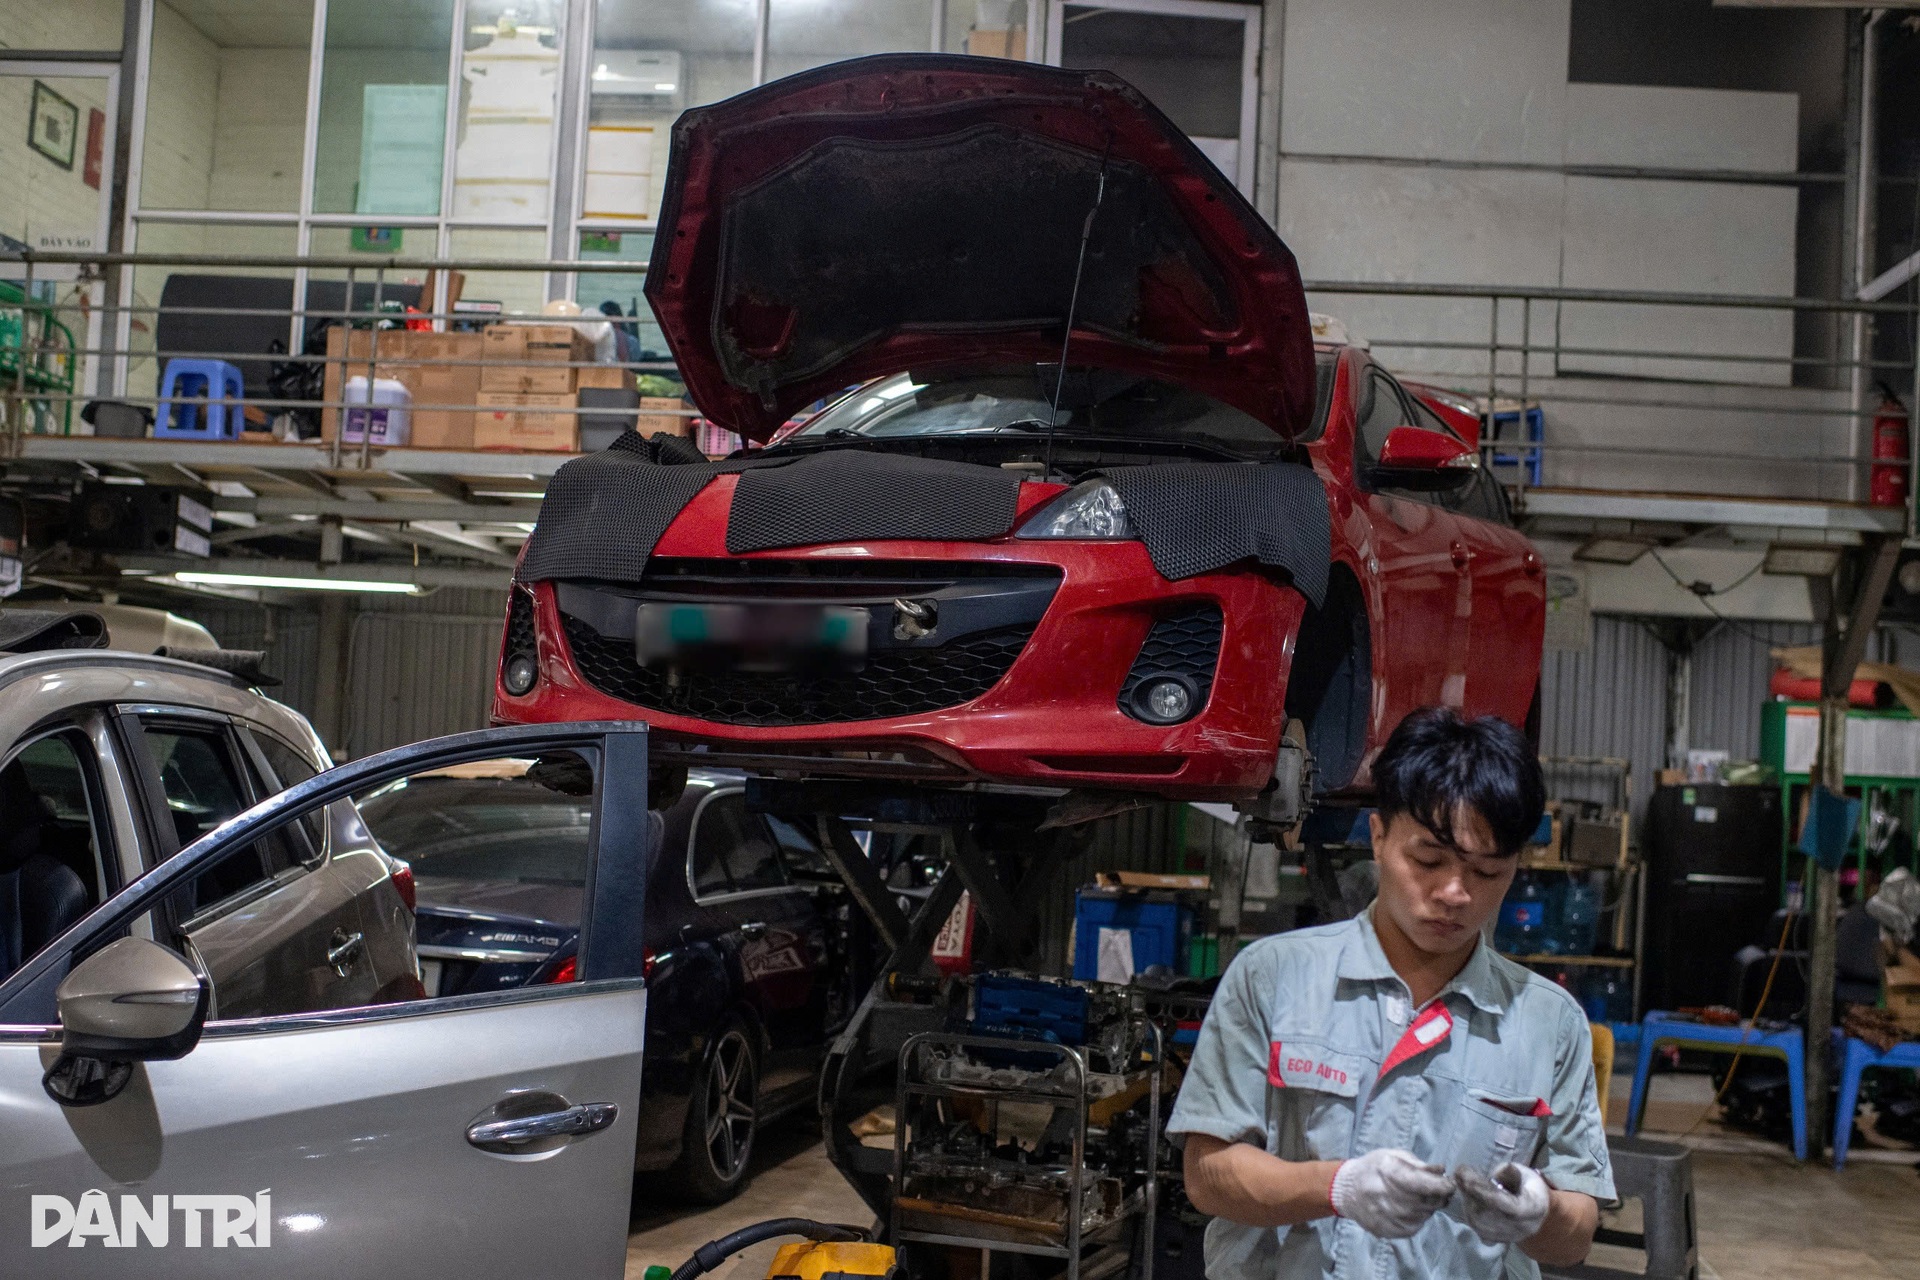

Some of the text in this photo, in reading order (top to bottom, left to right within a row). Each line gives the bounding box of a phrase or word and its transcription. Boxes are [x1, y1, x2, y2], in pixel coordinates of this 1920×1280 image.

[515, 934, 560, 946] AMG
[1287, 1058, 1347, 1085] ECO AUTO
